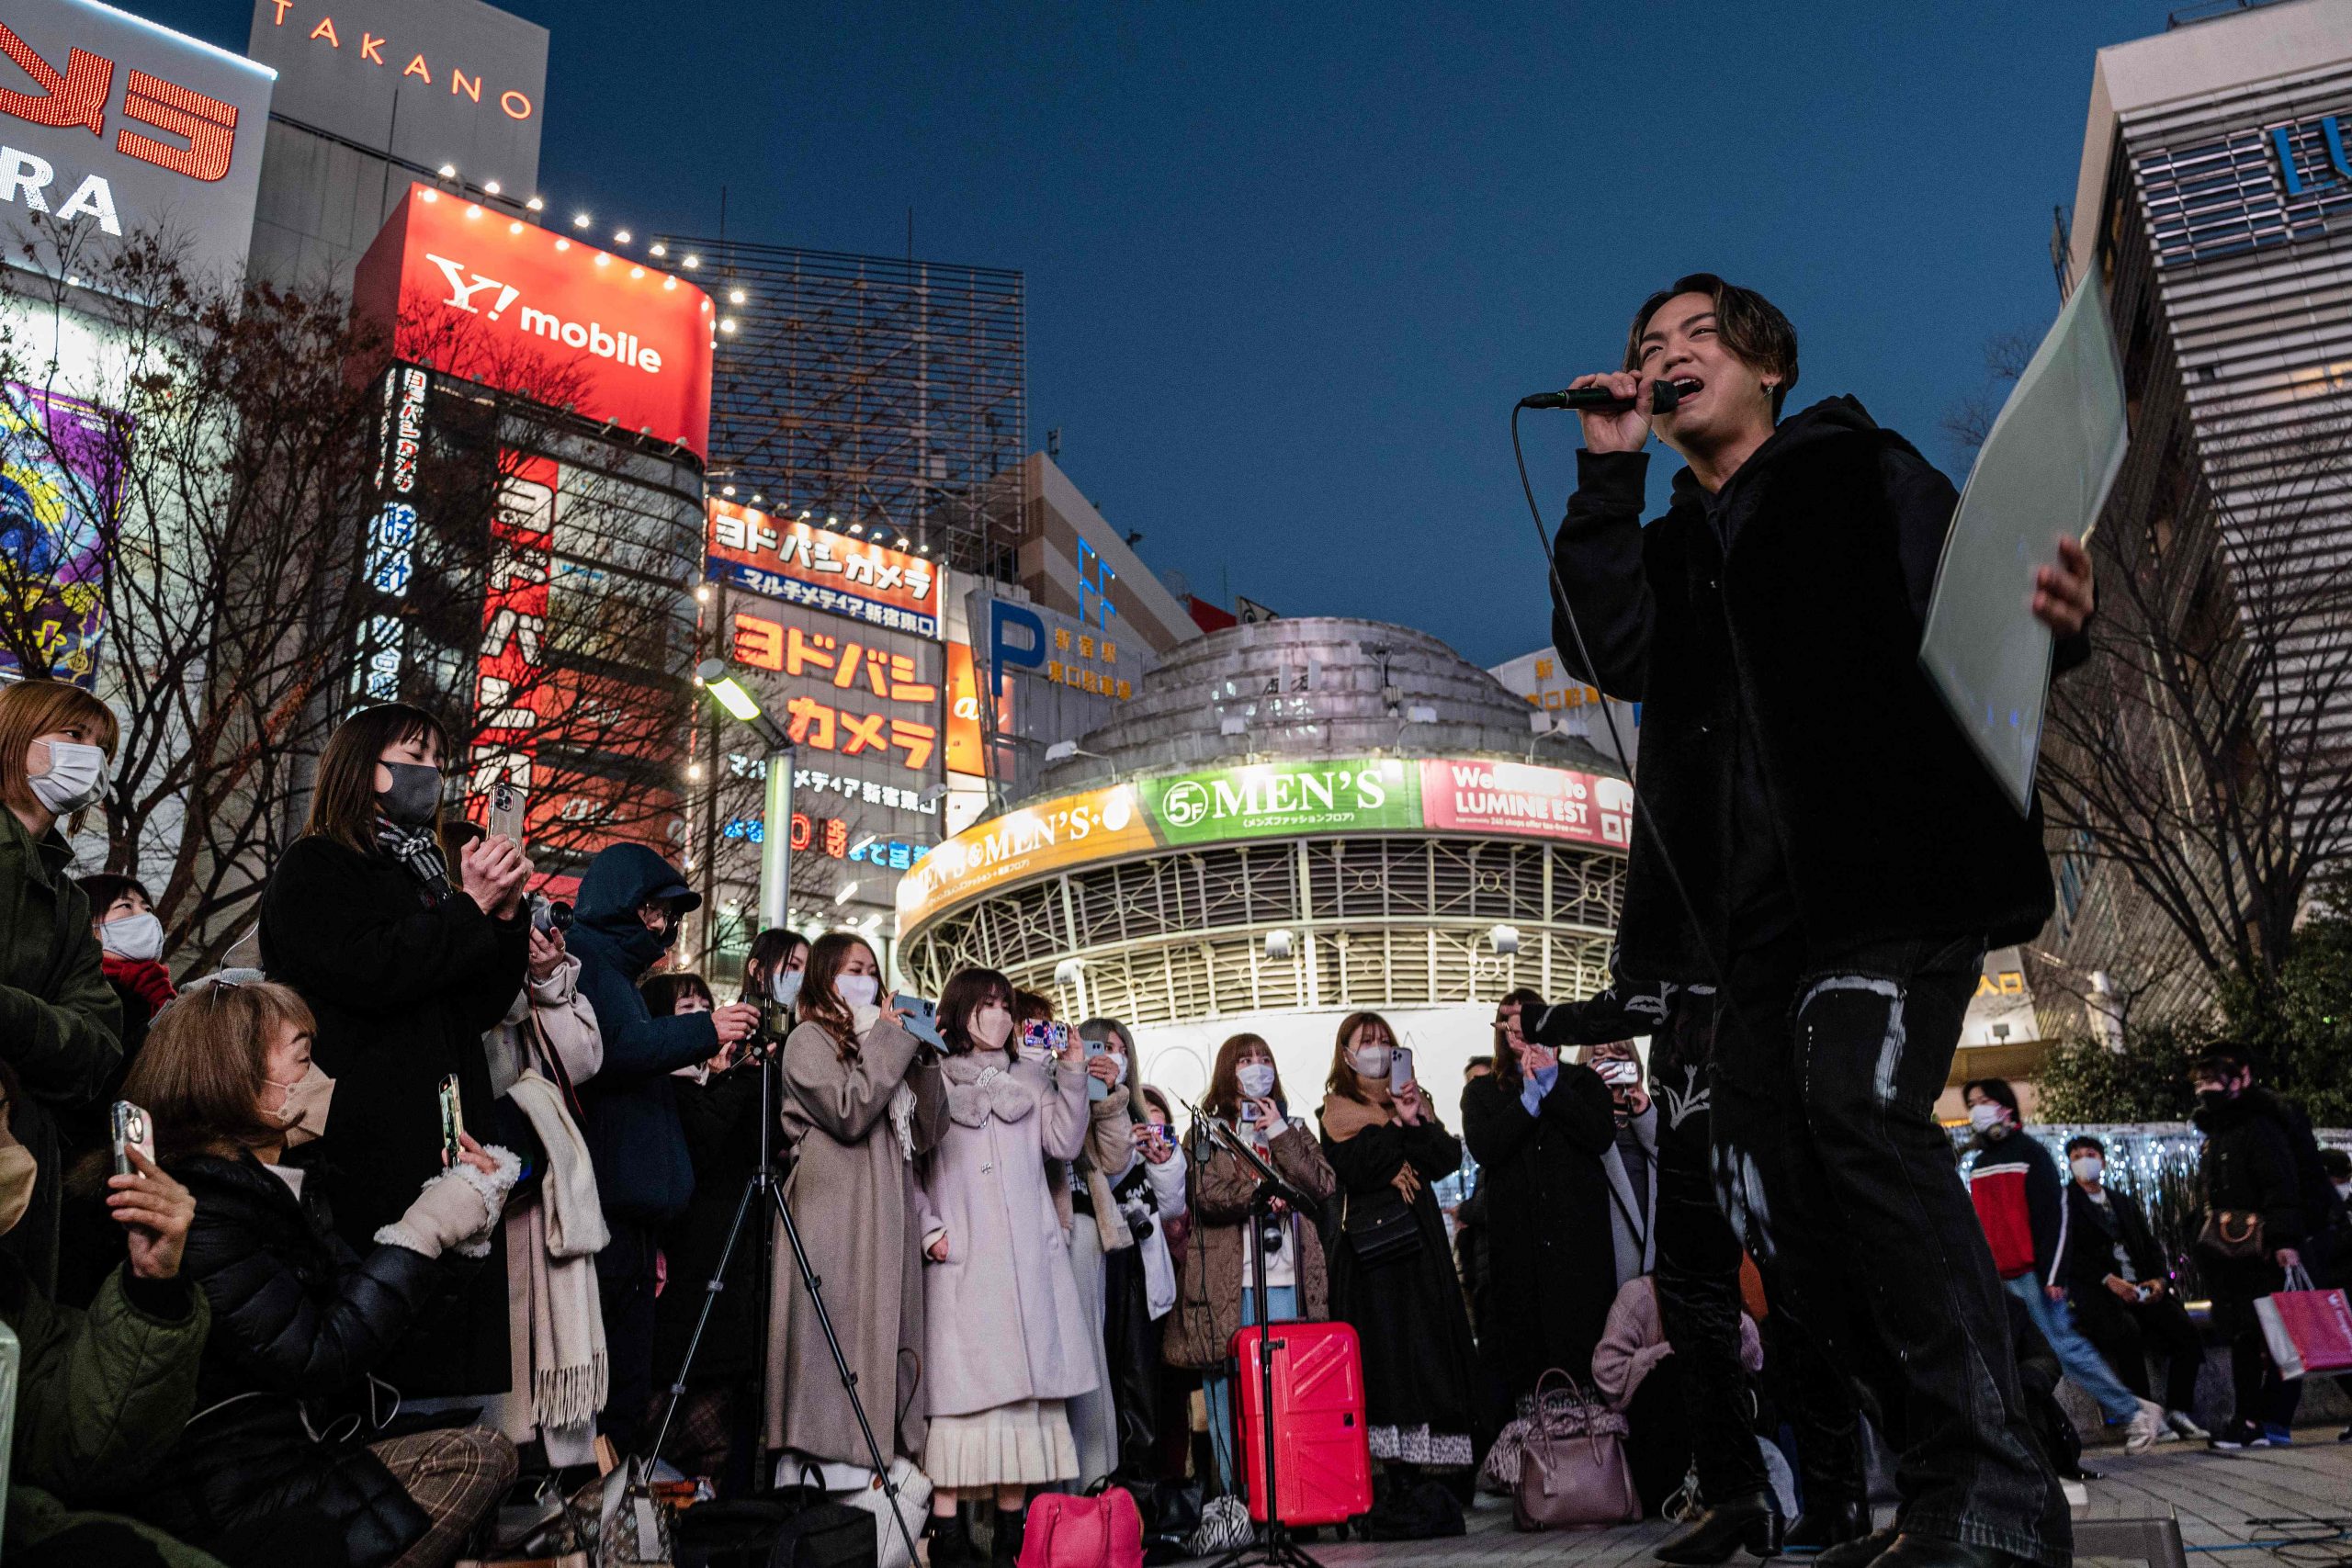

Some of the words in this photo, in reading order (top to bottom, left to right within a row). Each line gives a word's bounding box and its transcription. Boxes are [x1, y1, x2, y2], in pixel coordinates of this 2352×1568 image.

[272, 0, 533, 120] TAKANO
[715, 514, 933, 601] ヨドバシカメラ
[734, 613, 937, 704] ヨドバシ
[990, 598, 1046, 698] P
[786, 696, 936, 770] カメラ
[1169, 791, 1204, 822] 5F
[1210, 770, 1386, 819] MEN'S
[1455, 791, 1549, 820] LUMINE
[1551, 798, 1589, 825] EST
